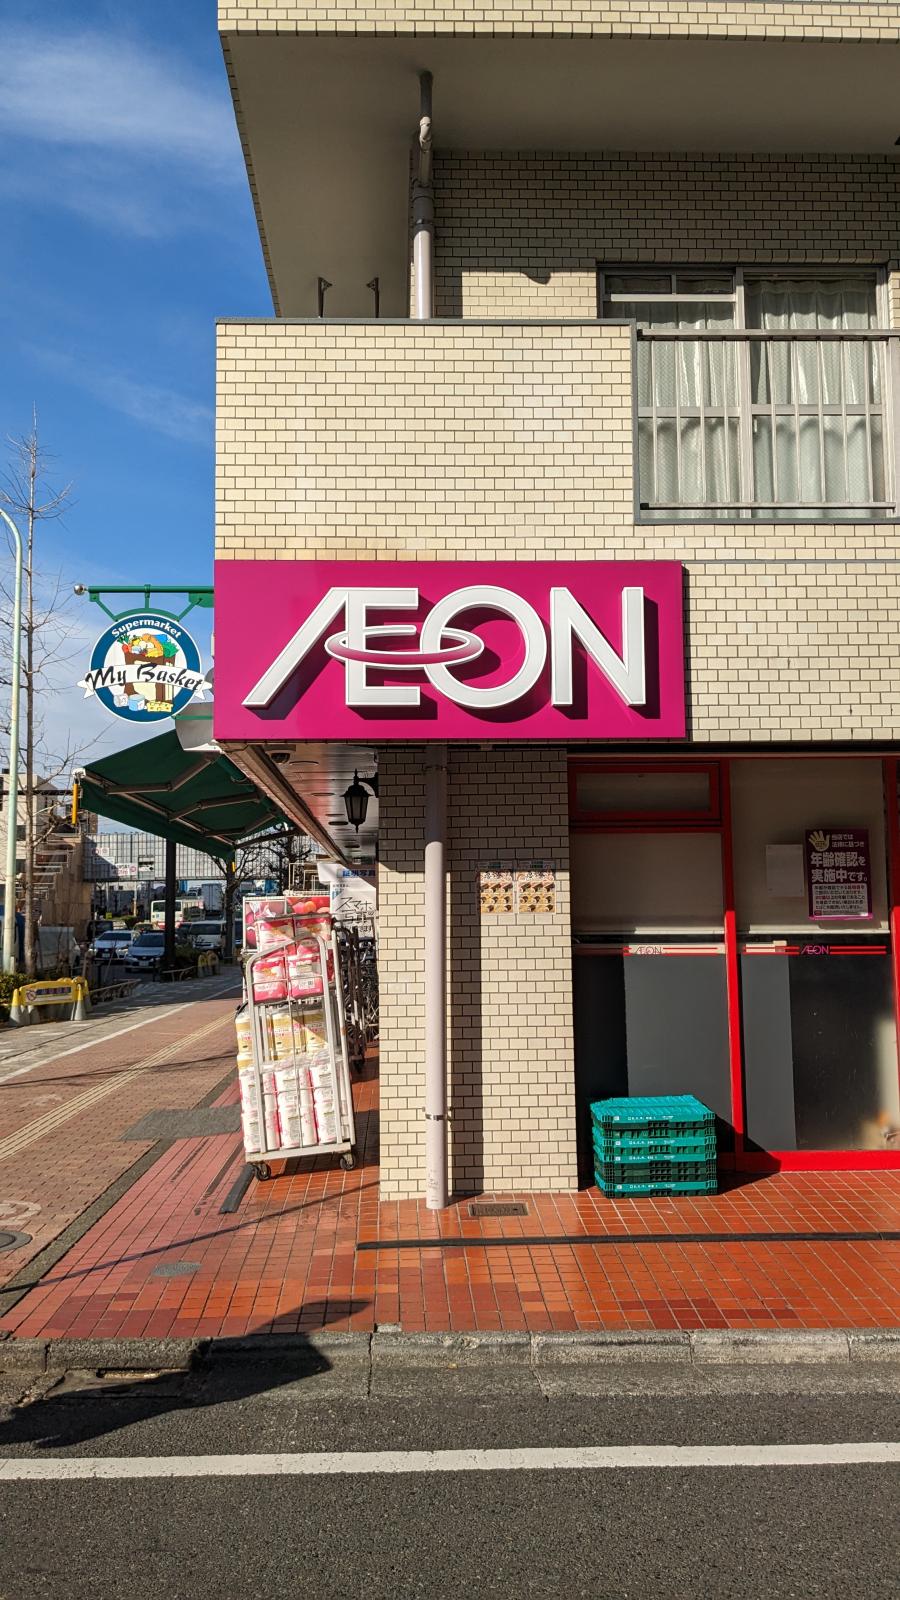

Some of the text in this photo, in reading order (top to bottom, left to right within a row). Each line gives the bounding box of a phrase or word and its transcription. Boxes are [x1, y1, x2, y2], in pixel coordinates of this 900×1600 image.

[111, 619, 182, 639] Supermarket
[85, 662, 203, 691] My Basket
[810, 851, 866, 867] 年齢確認を
[811, 868, 868, 883] 実施中です。
